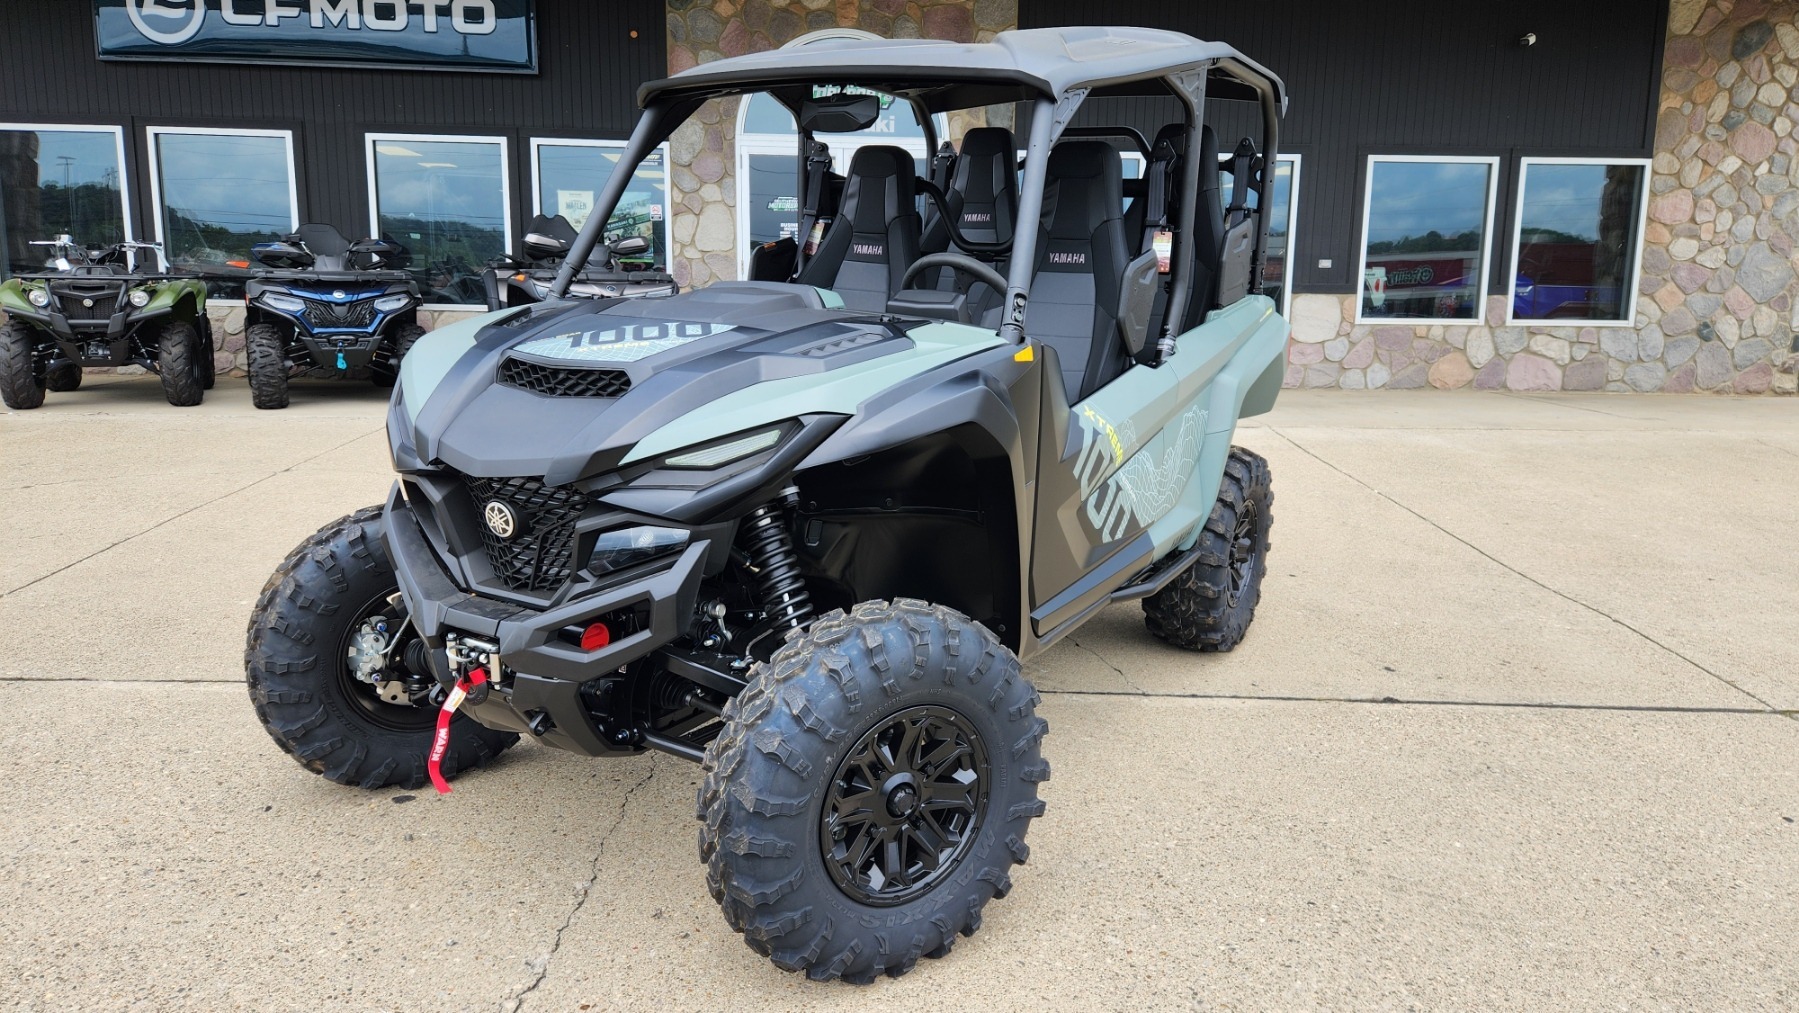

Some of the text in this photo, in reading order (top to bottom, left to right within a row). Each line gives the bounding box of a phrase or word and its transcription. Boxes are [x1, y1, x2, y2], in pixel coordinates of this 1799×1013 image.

[221, 0, 497, 35] CFMOTO
[963, 213, 991, 222] YAMAHA
[852, 244, 883, 256] YAMAHA
[1049, 252, 1085, 264] YAMAHA
[567, 321, 713, 349] 1000
[431, 727, 448, 762] WARN
[857, 827, 997, 930] MAXXIS
